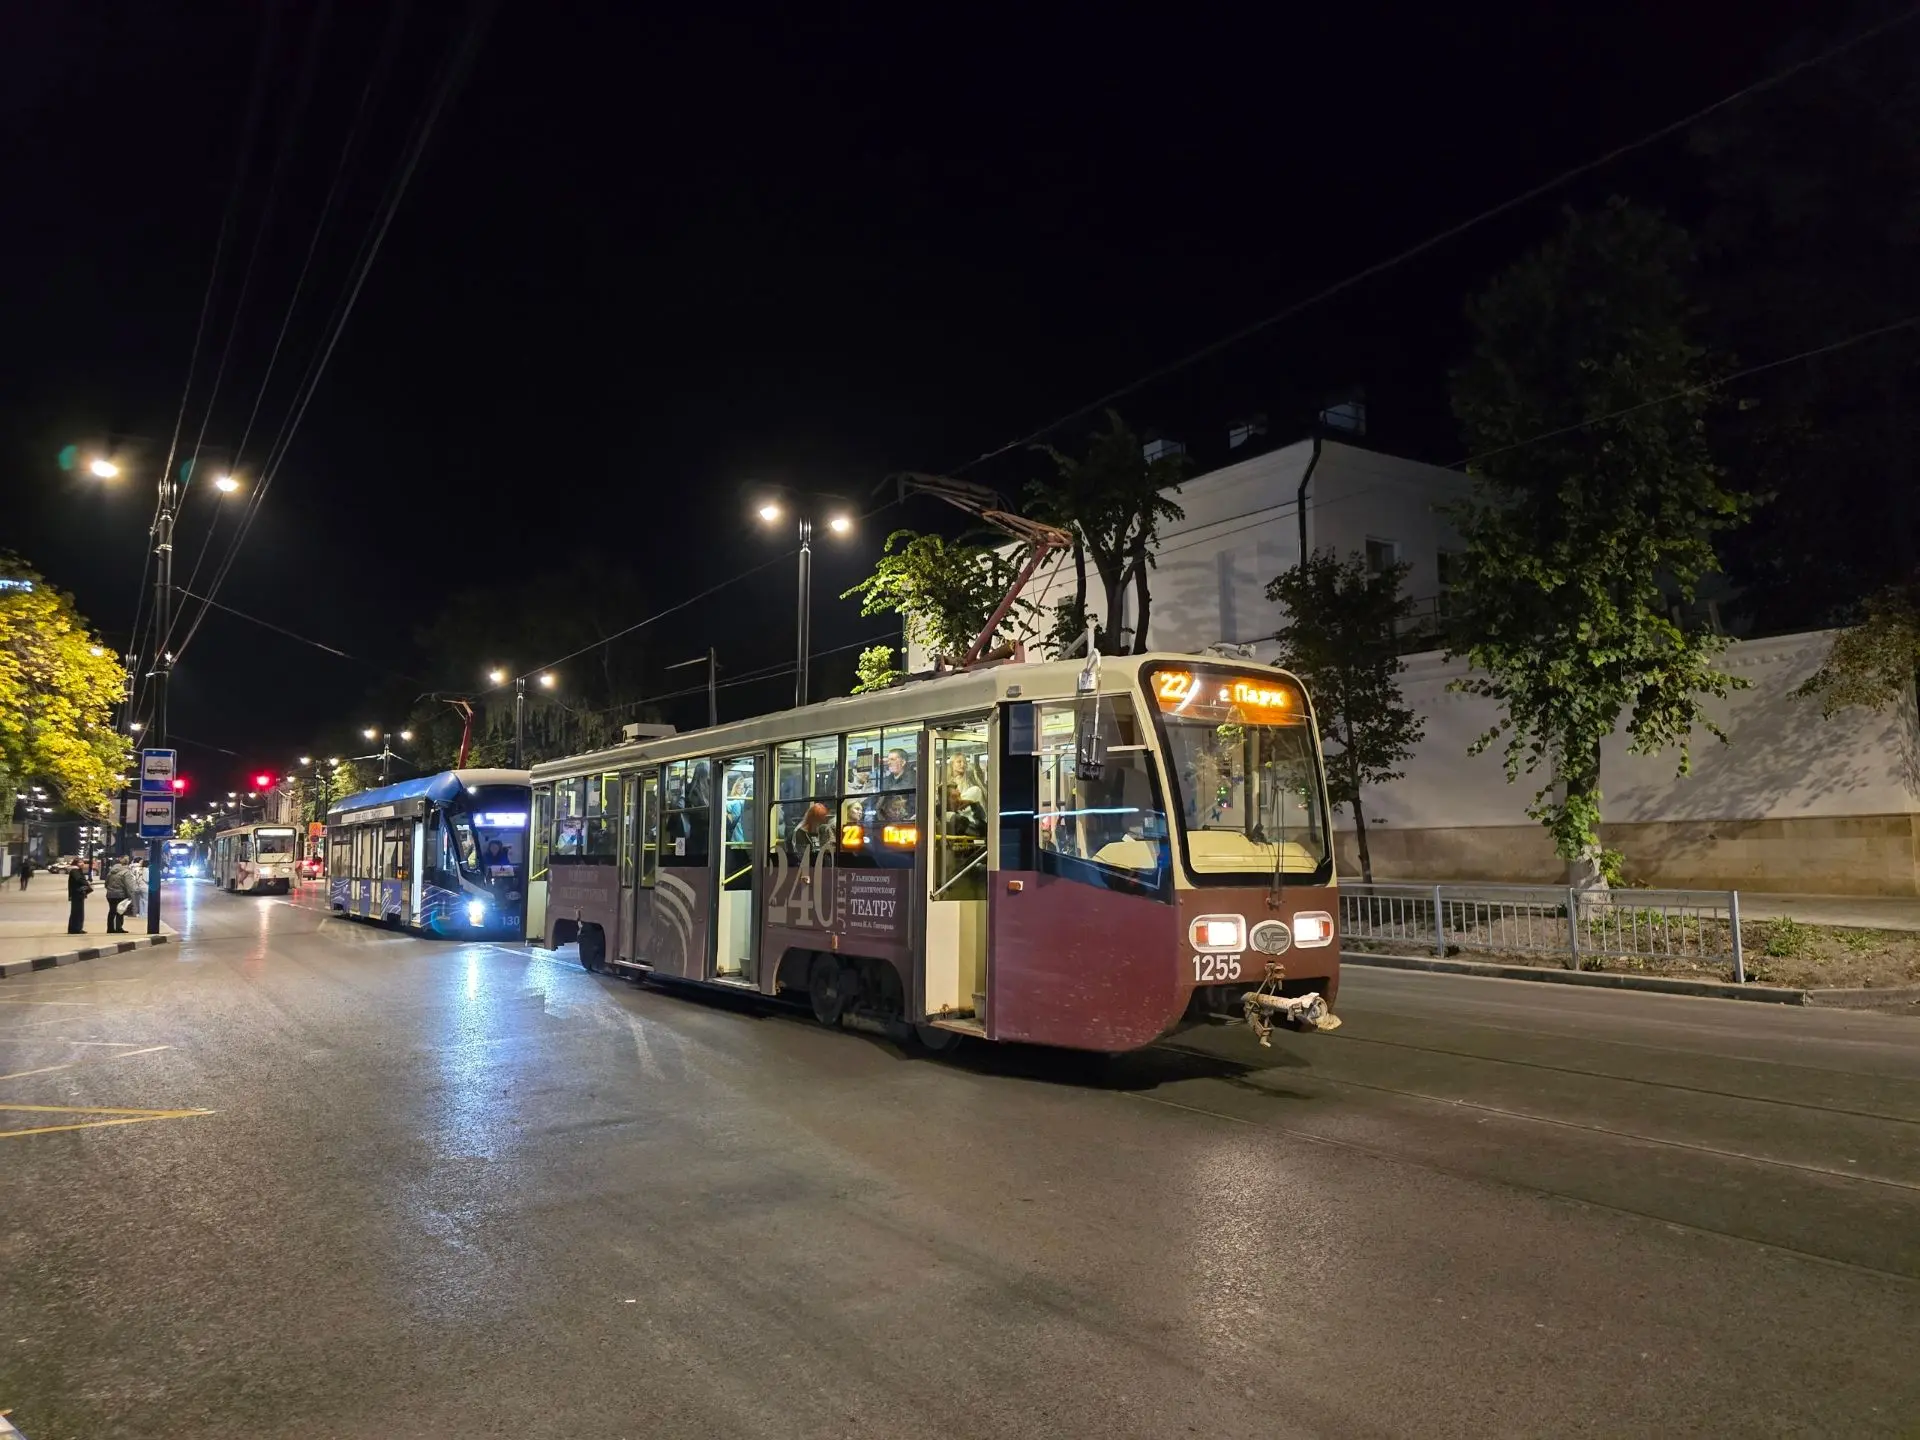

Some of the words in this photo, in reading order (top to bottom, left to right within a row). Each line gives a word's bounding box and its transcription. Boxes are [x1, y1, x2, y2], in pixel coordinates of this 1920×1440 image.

[1235, 683, 1286, 708] Парк
[768, 842, 835, 927] 240
[837, 868, 847, 929] ЛЕТ
[850, 899, 897, 918] ТЕАТРУ
[503, 915, 520, 926] 130
[1192, 954, 1242, 982] 1255
